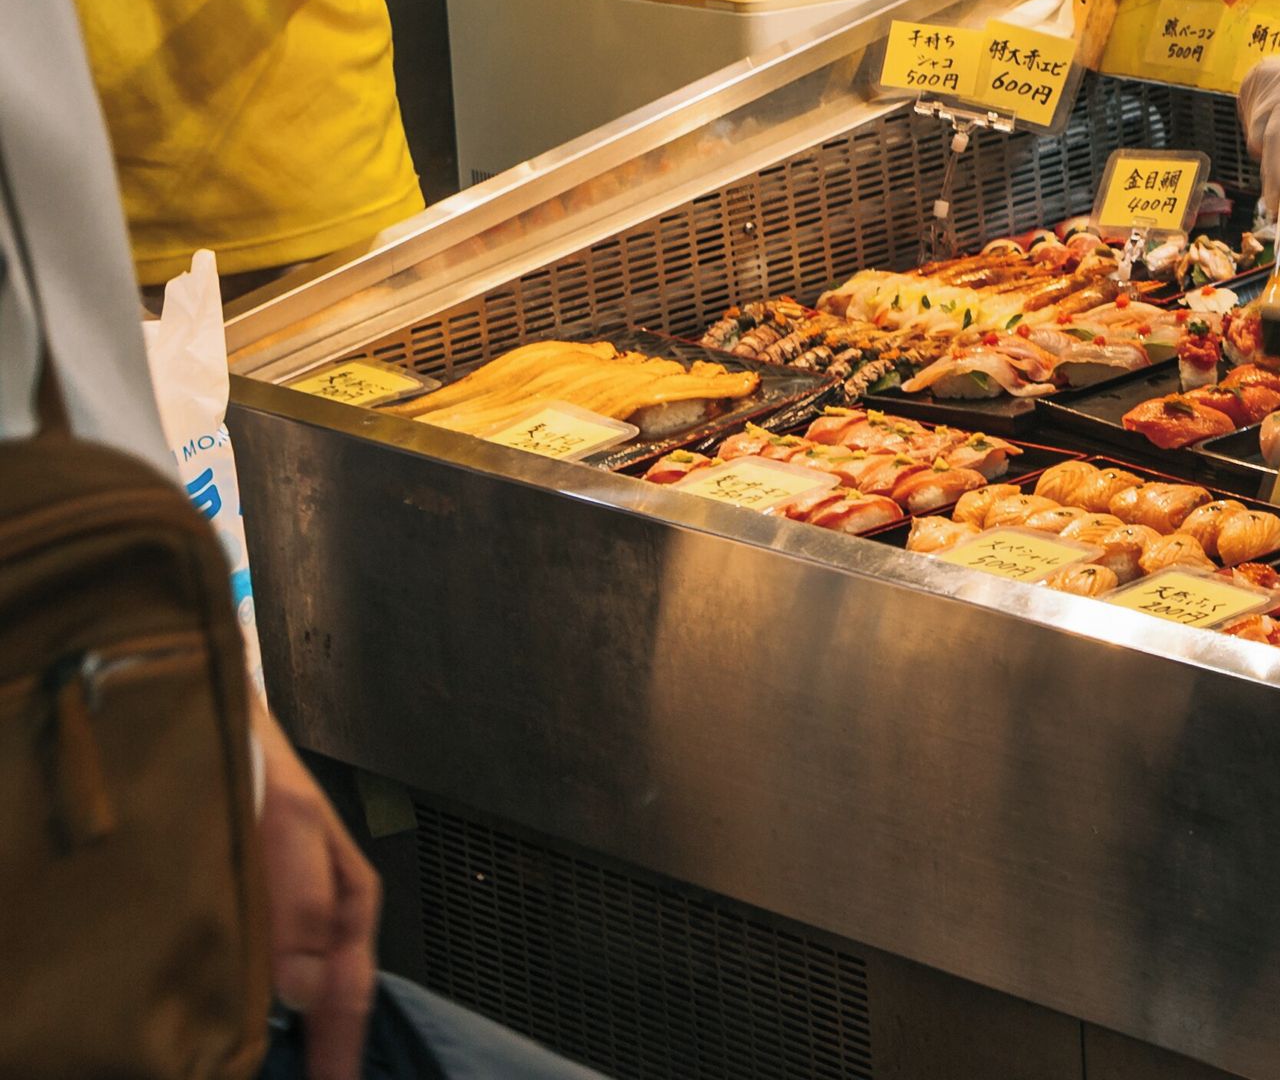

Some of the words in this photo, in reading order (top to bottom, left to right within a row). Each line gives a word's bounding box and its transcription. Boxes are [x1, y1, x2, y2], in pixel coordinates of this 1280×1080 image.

[908, 29, 956, 51] 子持ち
[917, 56, 954, 69] シャコ
[989, 38, 1067, 77] 特大赤エビ
[1167, 43, 1204, 63] 500円
[906, 69, 960, 91] 500円
[991, 71, 1053, 106] 600円
[1123, 167, 1183, 193] 金目鯛
[1127, 195, 1178, 214] 400円
[980, 540, 1062, 566] スペシャル
[968, 554, 1037, 579] 500円
[1138, 601, 1210, 624] 200円
